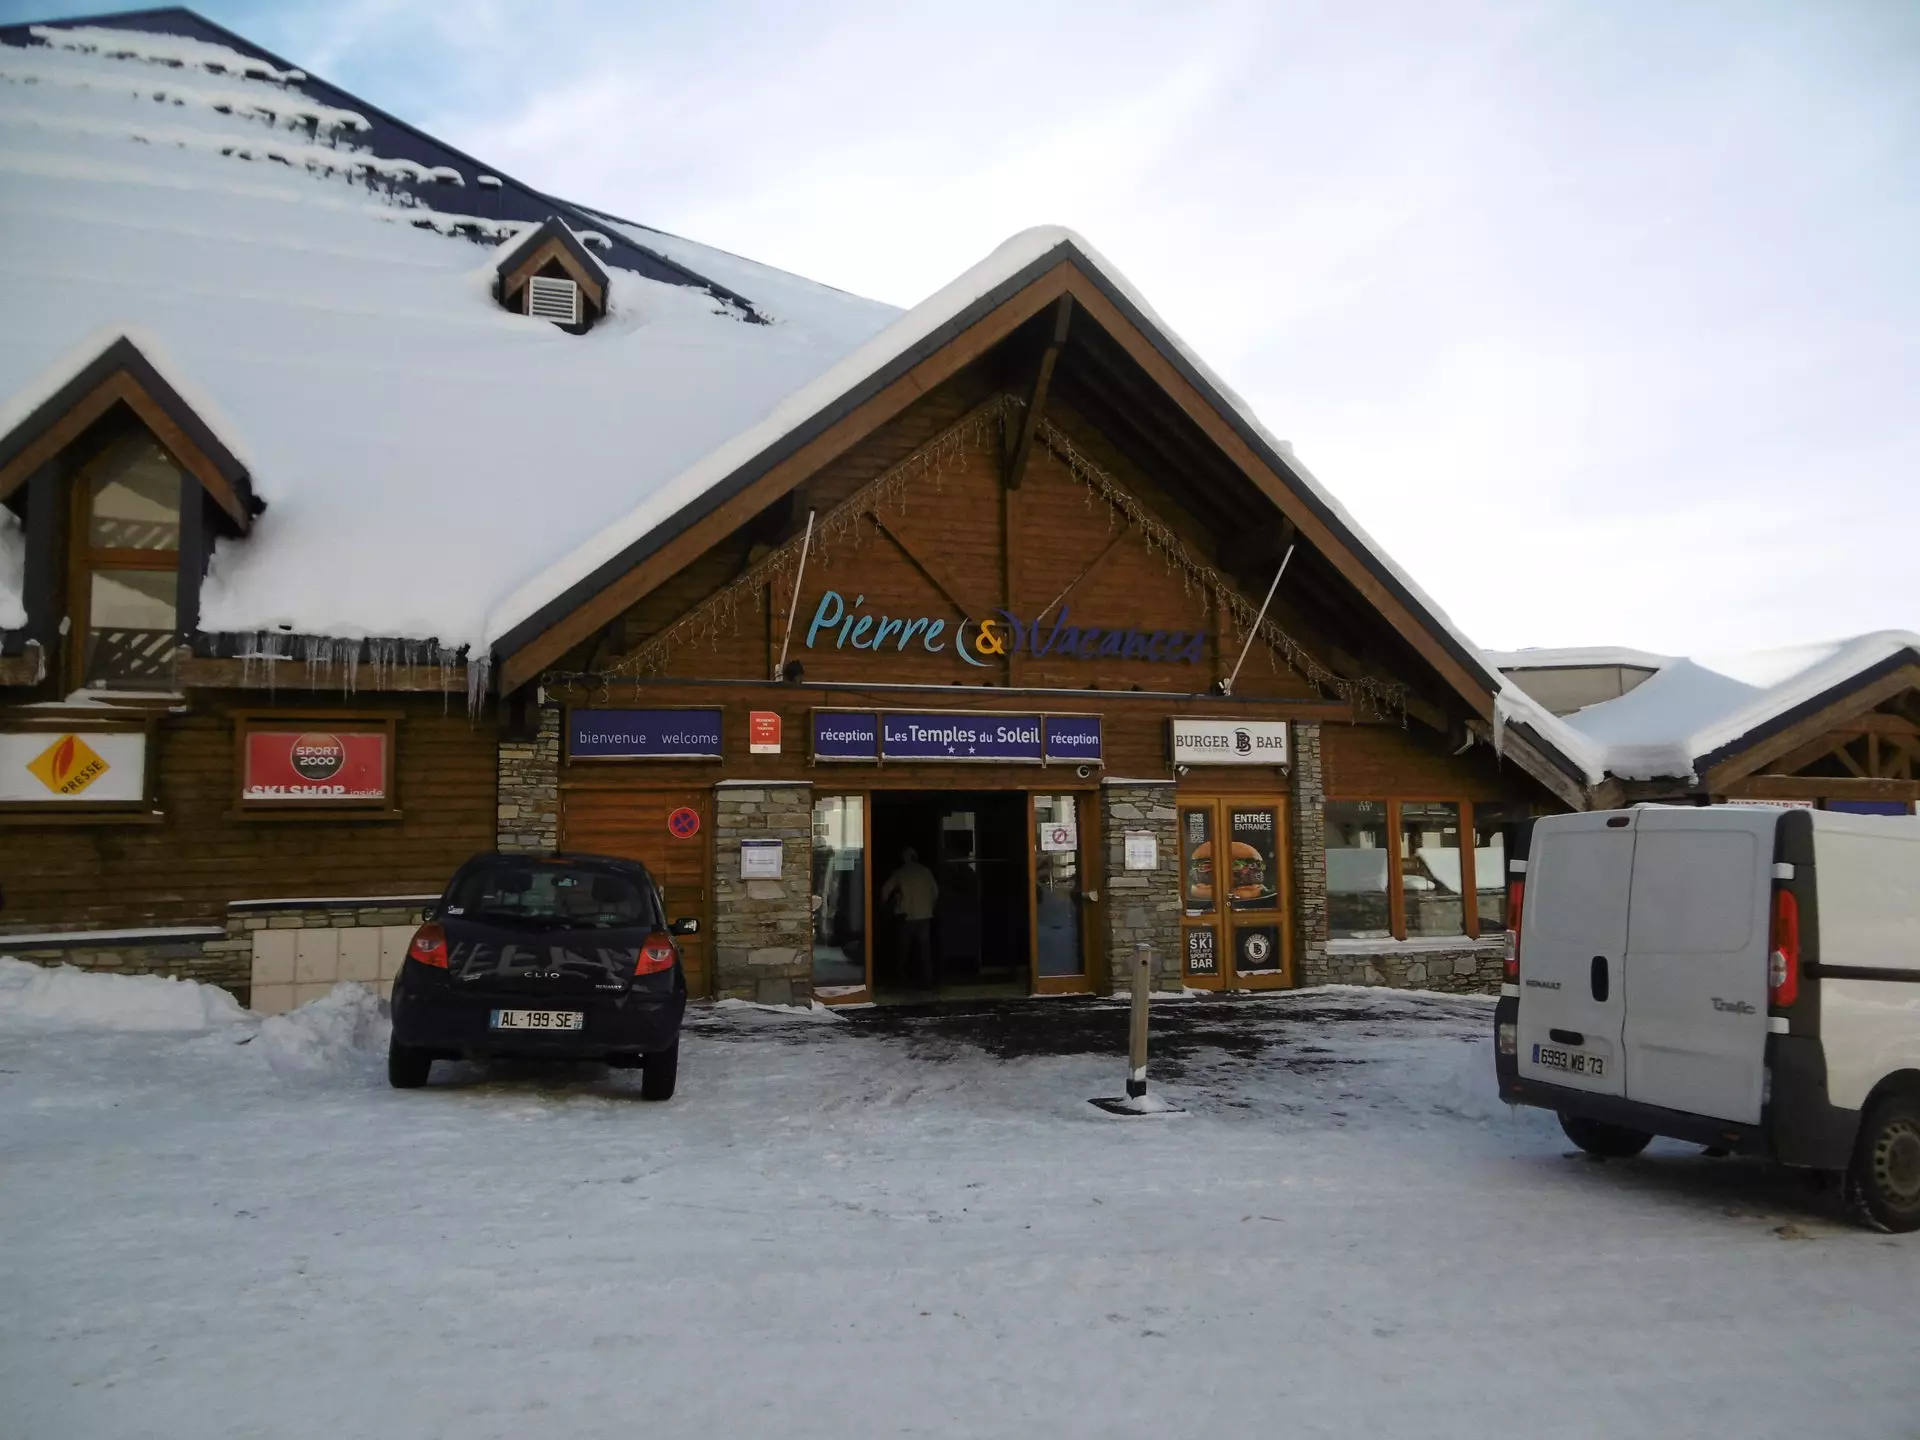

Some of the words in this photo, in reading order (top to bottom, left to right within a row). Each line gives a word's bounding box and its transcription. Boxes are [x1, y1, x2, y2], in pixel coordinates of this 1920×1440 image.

[806, 590, 946, 653] Pierre
[975, 619, 1005, 655] &
[1029, 604, 1207, 664] Vacances
[579, 730, 647, 744] bienvenue
[661, 732, 719, 745] welcome
[820, 728, 874, 744] réception
[885, 725, 908, 742] Les
[908, 725, 977, 745] Temples
[980, 732, 993, 743] du
[997, 726, 1040, 744] Soleil
[1051, 733, 1099, 747] réception
[1175, 735, 1230, 748] BURGER
[1256, 736, 1283, 749] BAR
[296, 746, 340, 756] SPORT
[299, 756, 335, 766] 2000
[62, 760, 104, 795] PRESSE
[1234, 812, 1272, 823] ENTRÉE
[1234, 823, 1272, 831] ENTRANCE
[1189, 938, 1213, 949] SKI
[1190, 958, 1213, 969] BAR
